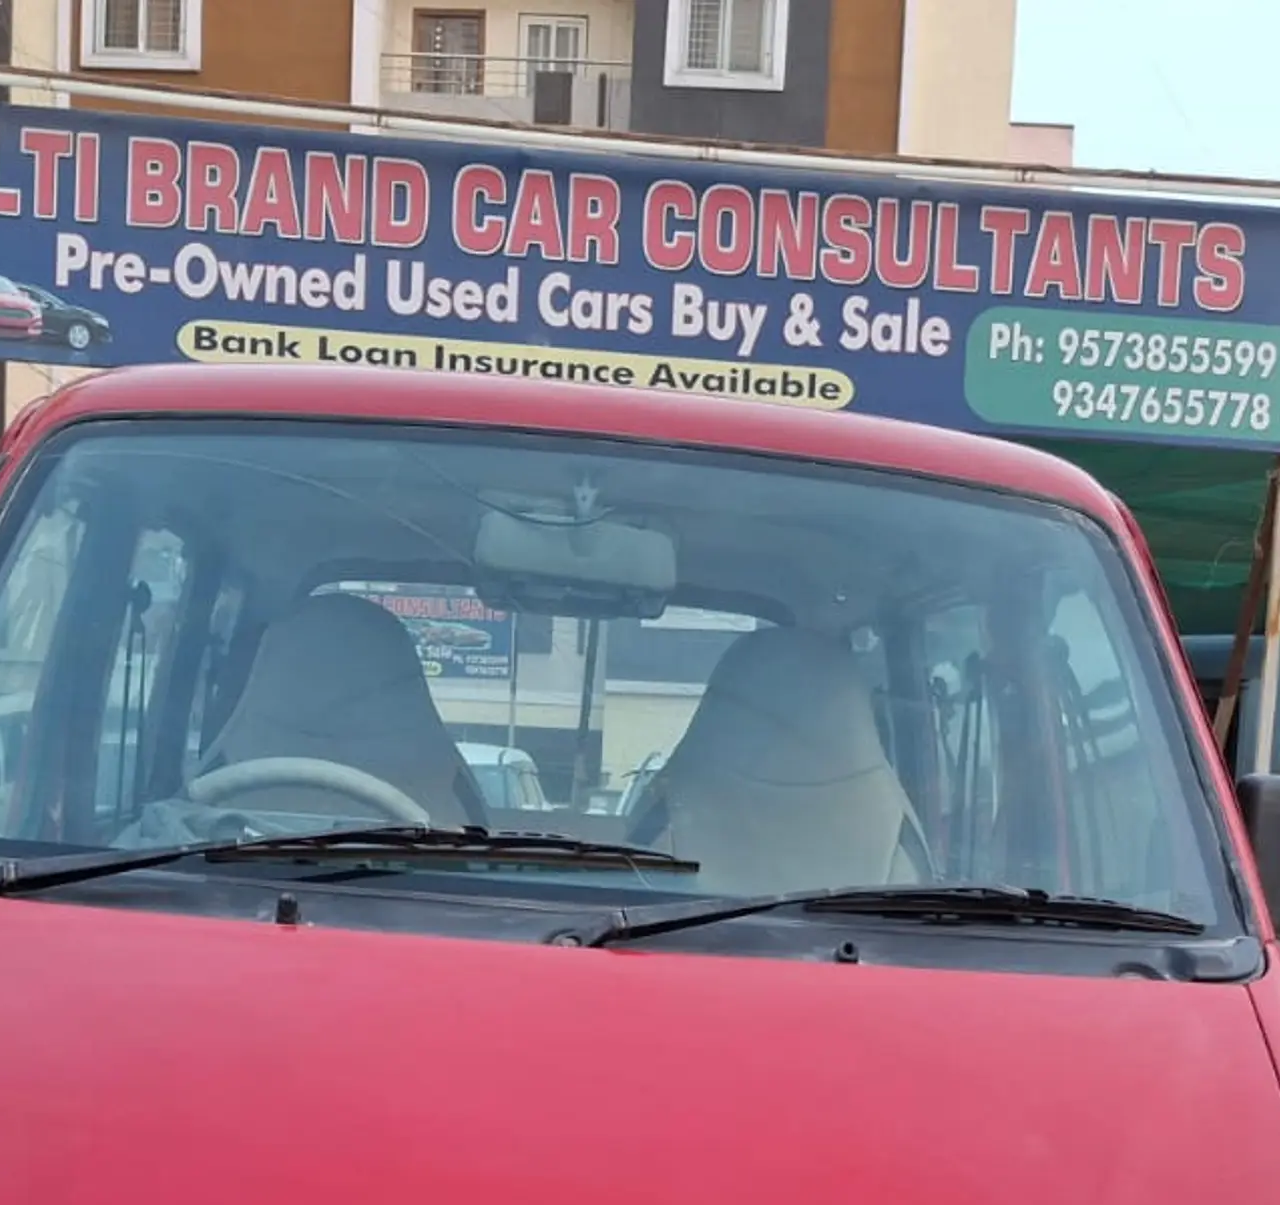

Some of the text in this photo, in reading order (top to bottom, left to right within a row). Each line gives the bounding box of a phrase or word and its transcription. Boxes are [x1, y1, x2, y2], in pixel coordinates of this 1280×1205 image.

[126, 137, 429, 248] BRAND
[453, 164, 620, 264] CAR
[642, 180, 1246, 311] CONSULTANTS
[55, 233, 951, 357] Pre-Owned Used Cars Buy & Sale
[193, 325, 842, 401] Bank Loan Insurance Available
[989, 322, 1278, 378] Ph: 9573855599
[1053, 379, 1271, 430] 9347655778
